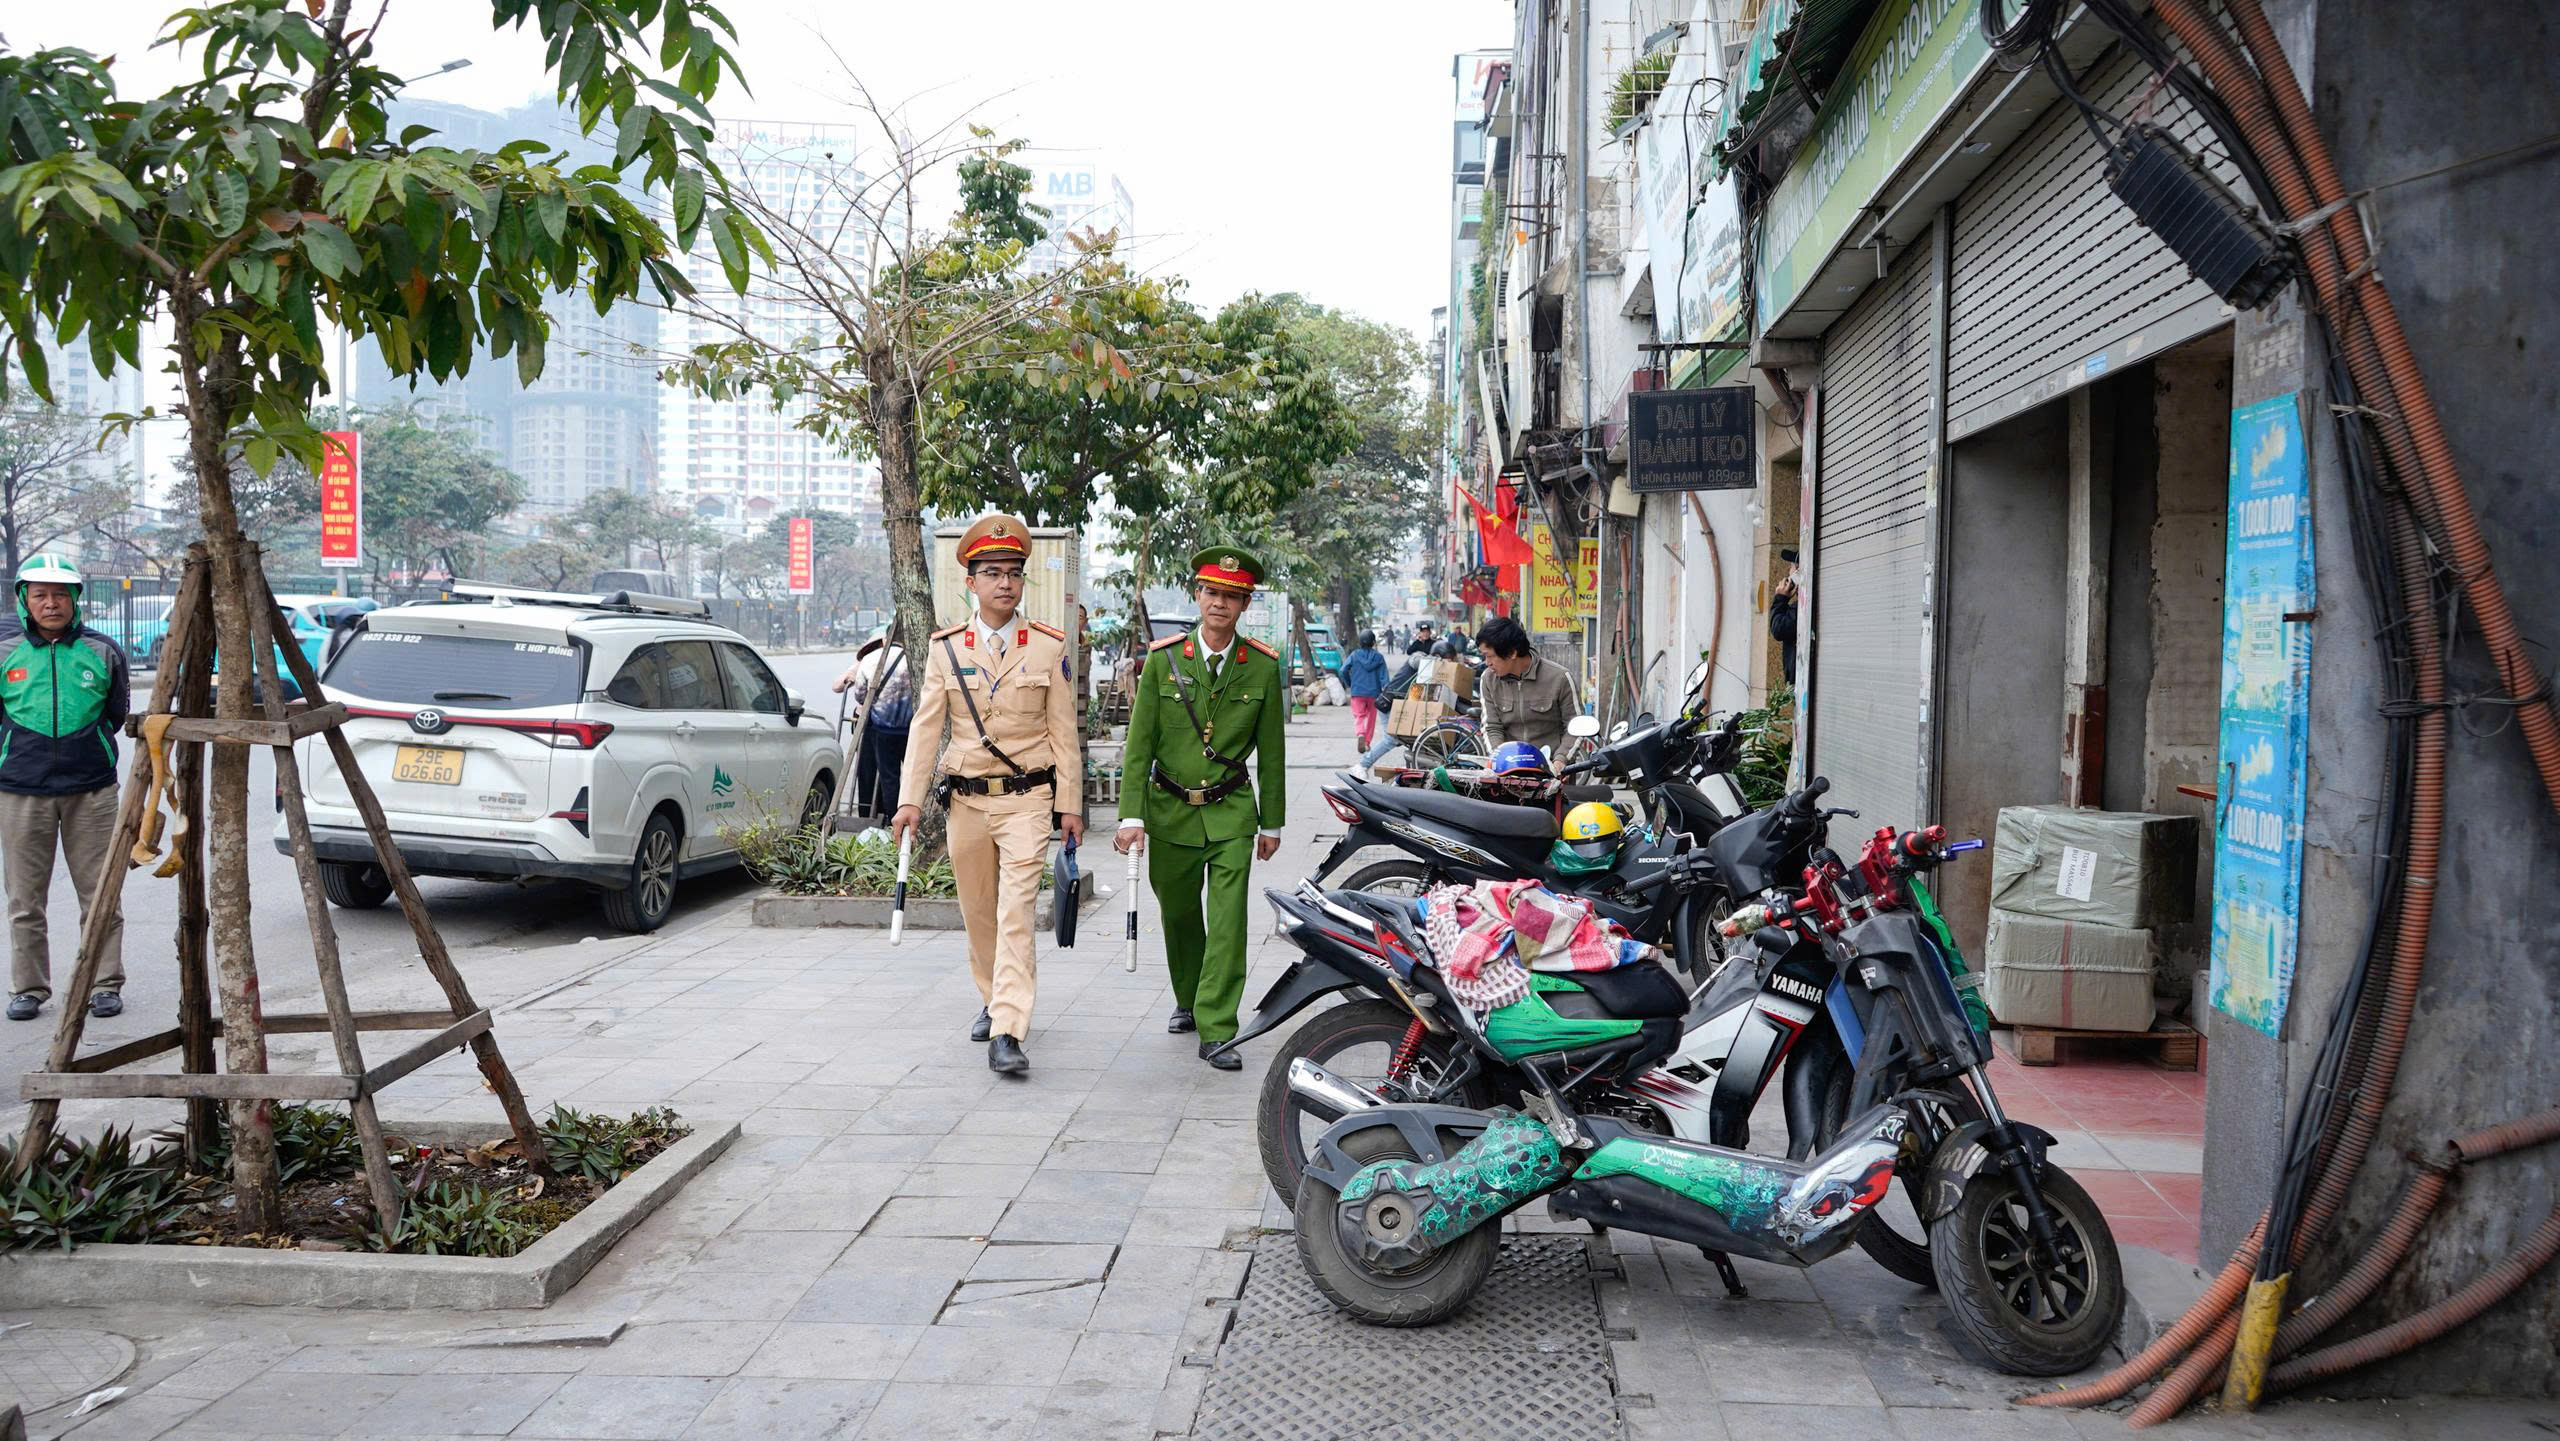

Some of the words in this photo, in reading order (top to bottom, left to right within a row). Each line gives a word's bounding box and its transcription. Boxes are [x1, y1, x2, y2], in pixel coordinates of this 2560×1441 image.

[1846, 78, 1869, 158] LOẠI
[1871, 39, 1895, 118] TẠP
[1048, 172, 1092, 196] MB
[1657, 404, 1695, 433] ĐẠI
[1701, 397, 1726, 428] LÝ
[1639, 433, 1697, 464] BÁNH
[1702, 435, 1747, 465] KẸO
[2239, 493, 2296, 538] 1.000.000
[514, 642, 527, 652] XE
[415, 749, 446, 764] 29E
[400, 764, 453, 781] 026.60
[1580, 823, 1601, 836] be
[1771, 973, 1823, 1004] YAMAHA
